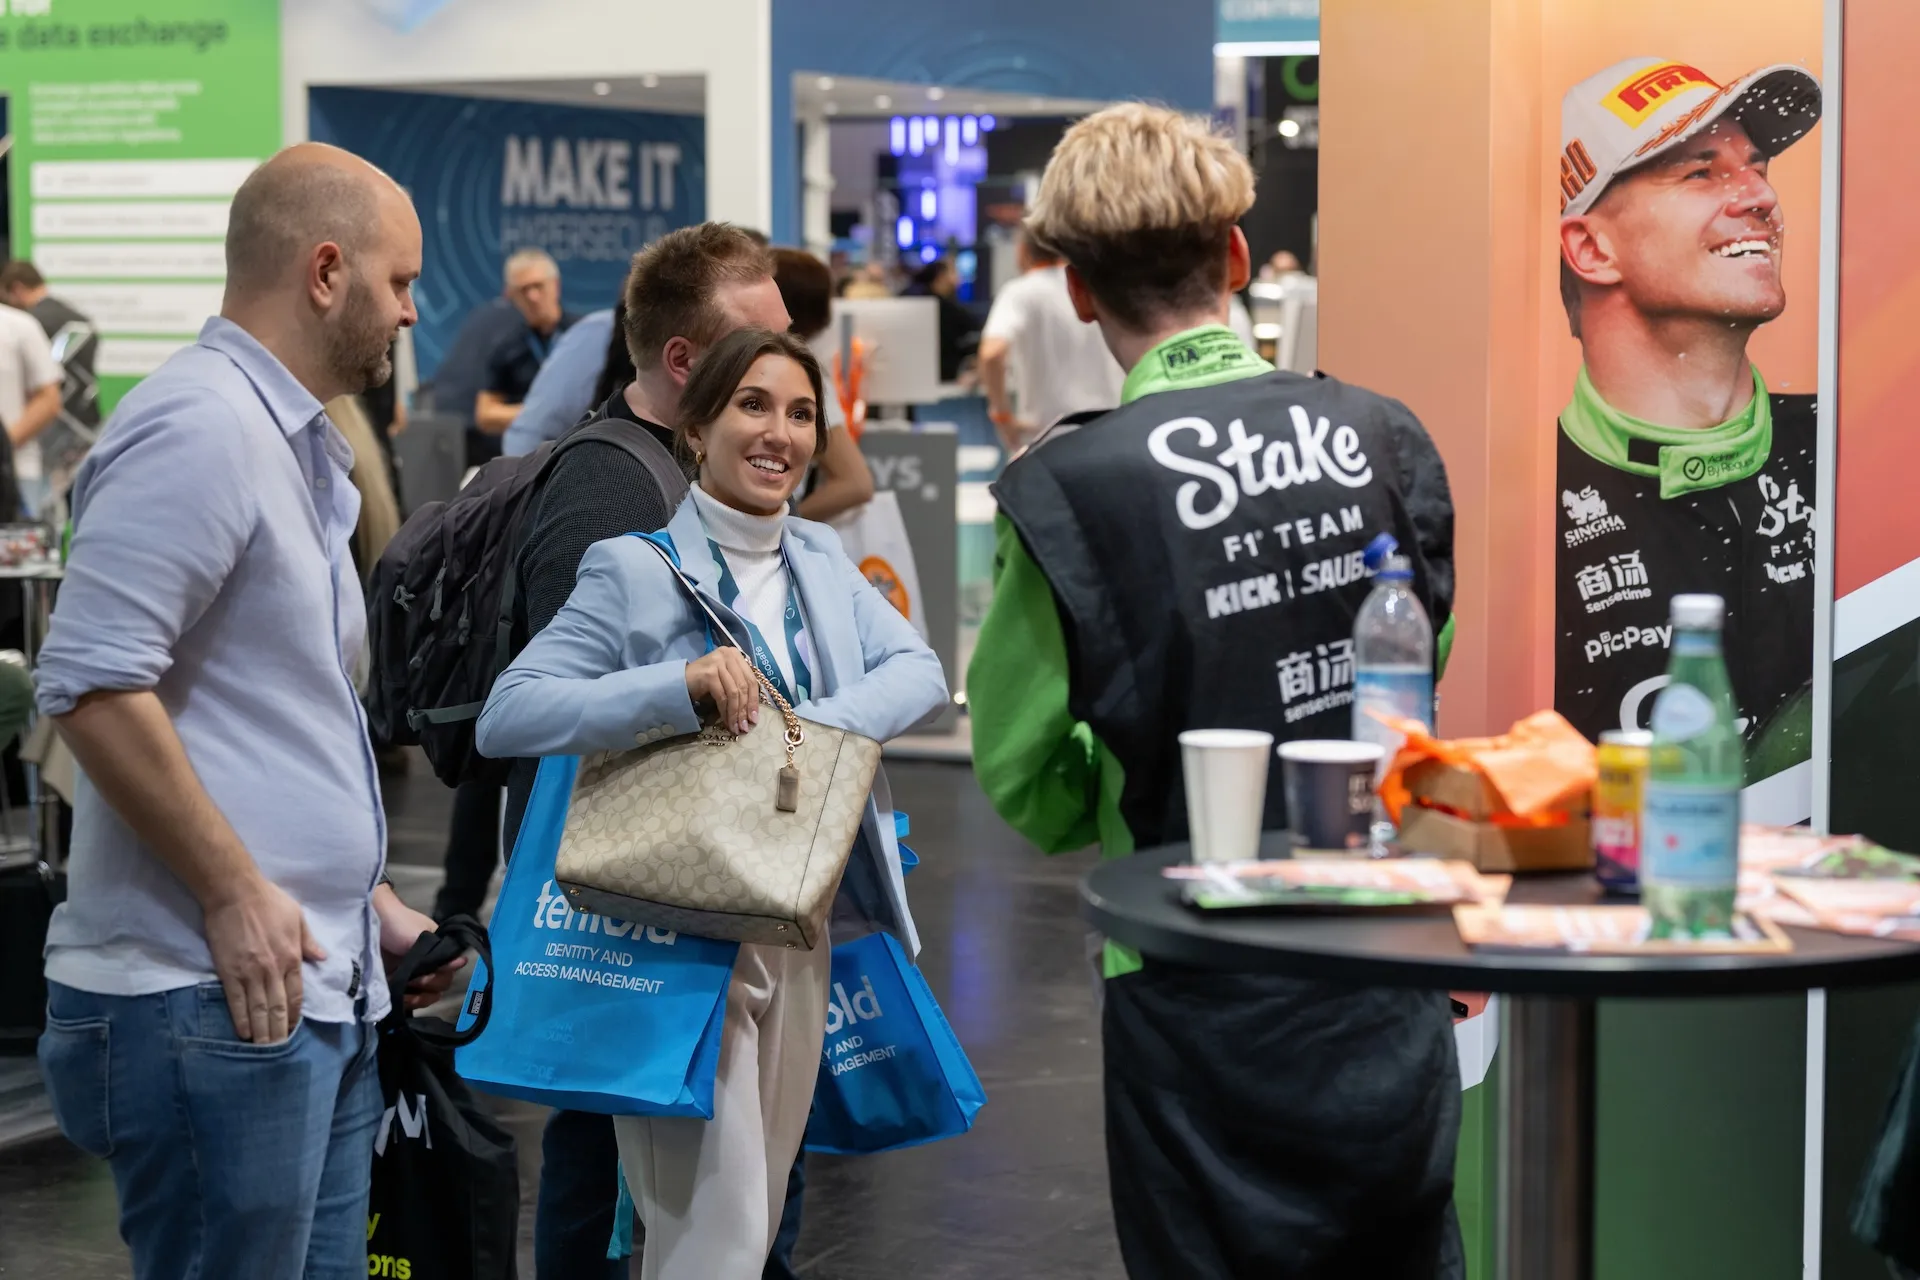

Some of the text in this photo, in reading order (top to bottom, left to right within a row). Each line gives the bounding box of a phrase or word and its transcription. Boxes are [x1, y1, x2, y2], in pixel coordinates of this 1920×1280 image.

[87, 15, 228, 52] exchange
[503, 135, 681, 210] MAKE IT
[1167, 348, 1199, 368] FIA
[1147, 405, 1373, 530] Stake
[1707, 465, 1720, 477] By
[1273, 505, 1363, 549] TEAM
[1564, 515, 1625, 543] SINGHA
[1205, 573, 1281, 619] KICK
[1585, 588, 1652, 613] sensetime
[756, 645, 774, 676] sosafe
[545, 943, 633, 967] IDENTITY AND
[514, 962, 664, 994] ACCESS MANAGEMENT
[835, 1036, 863, 1056] AND
